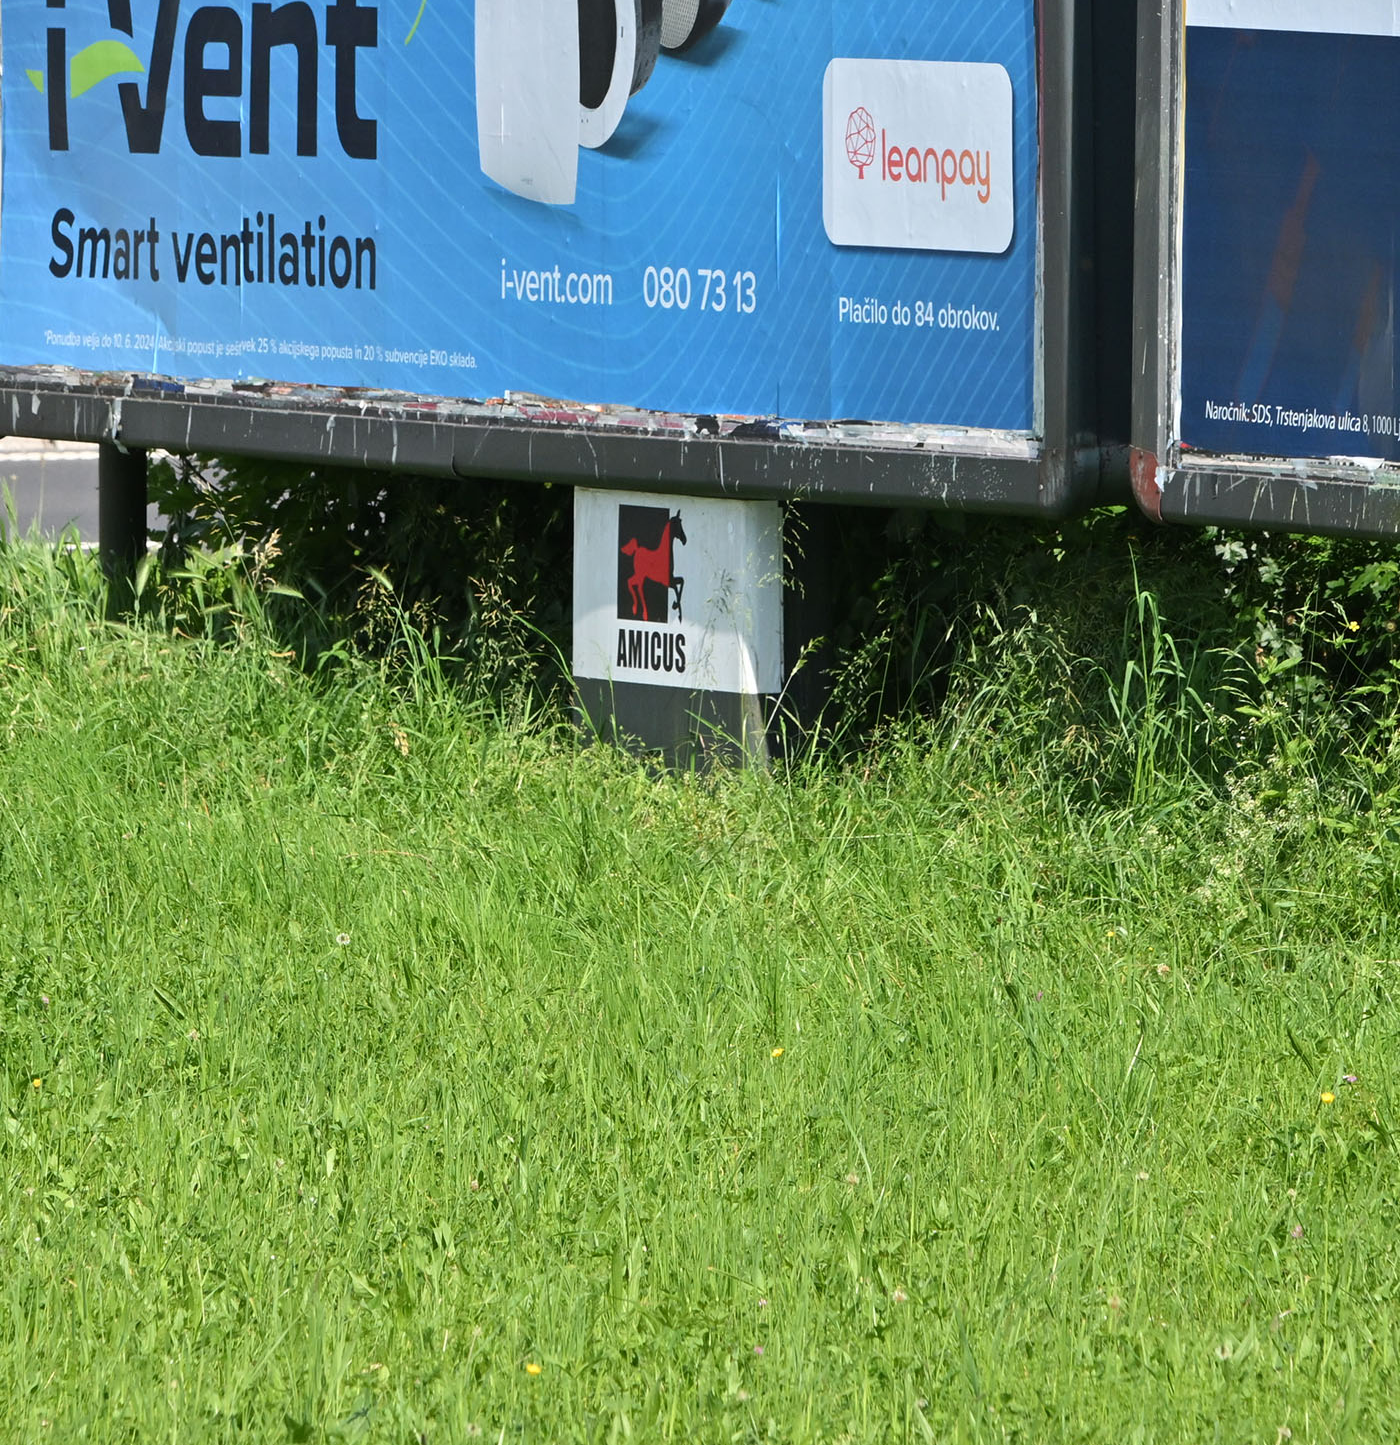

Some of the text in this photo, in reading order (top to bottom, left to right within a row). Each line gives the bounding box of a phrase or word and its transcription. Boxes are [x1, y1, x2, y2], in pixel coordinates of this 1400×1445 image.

[881, 128, 990, 204] leanpay
[49, 207, 377, 291] Smart ventilation
[501, 258, 613, 306] i-vent.com
[643, 265, 756, 314] 080 73 13
[838, 296, 1000, 332] Plačilo do 84 obrokov.
[101, 333, 112, 348] do
[187, 339, 215, 357] popust
[215, 340, 224, 358] je
[257, 338, 269, 354] 25
[278, 340, 320, 360] akcijskega
[321, 343, 353, 362] popusta
[354, 344, 363, 360] in
[364, 345, 375, 361] 20
[384, 347, 428, 368] subvencije
[429, 349, 448, 367] EKO
[449, 352, 478, 369] sklada.
[1205, 400, 1250, 423] Naročnik:
[1251, 403, 1273, 427] SDS,
[1275, 406, 1336, 433] Trstenjakova
[1338, 411, 1361, 433] ulica
[1362, 413, 1370, 436] 8,
[1372, 415, 1392, 436] 1000
[616, 628, 686, 674] AMICUS
